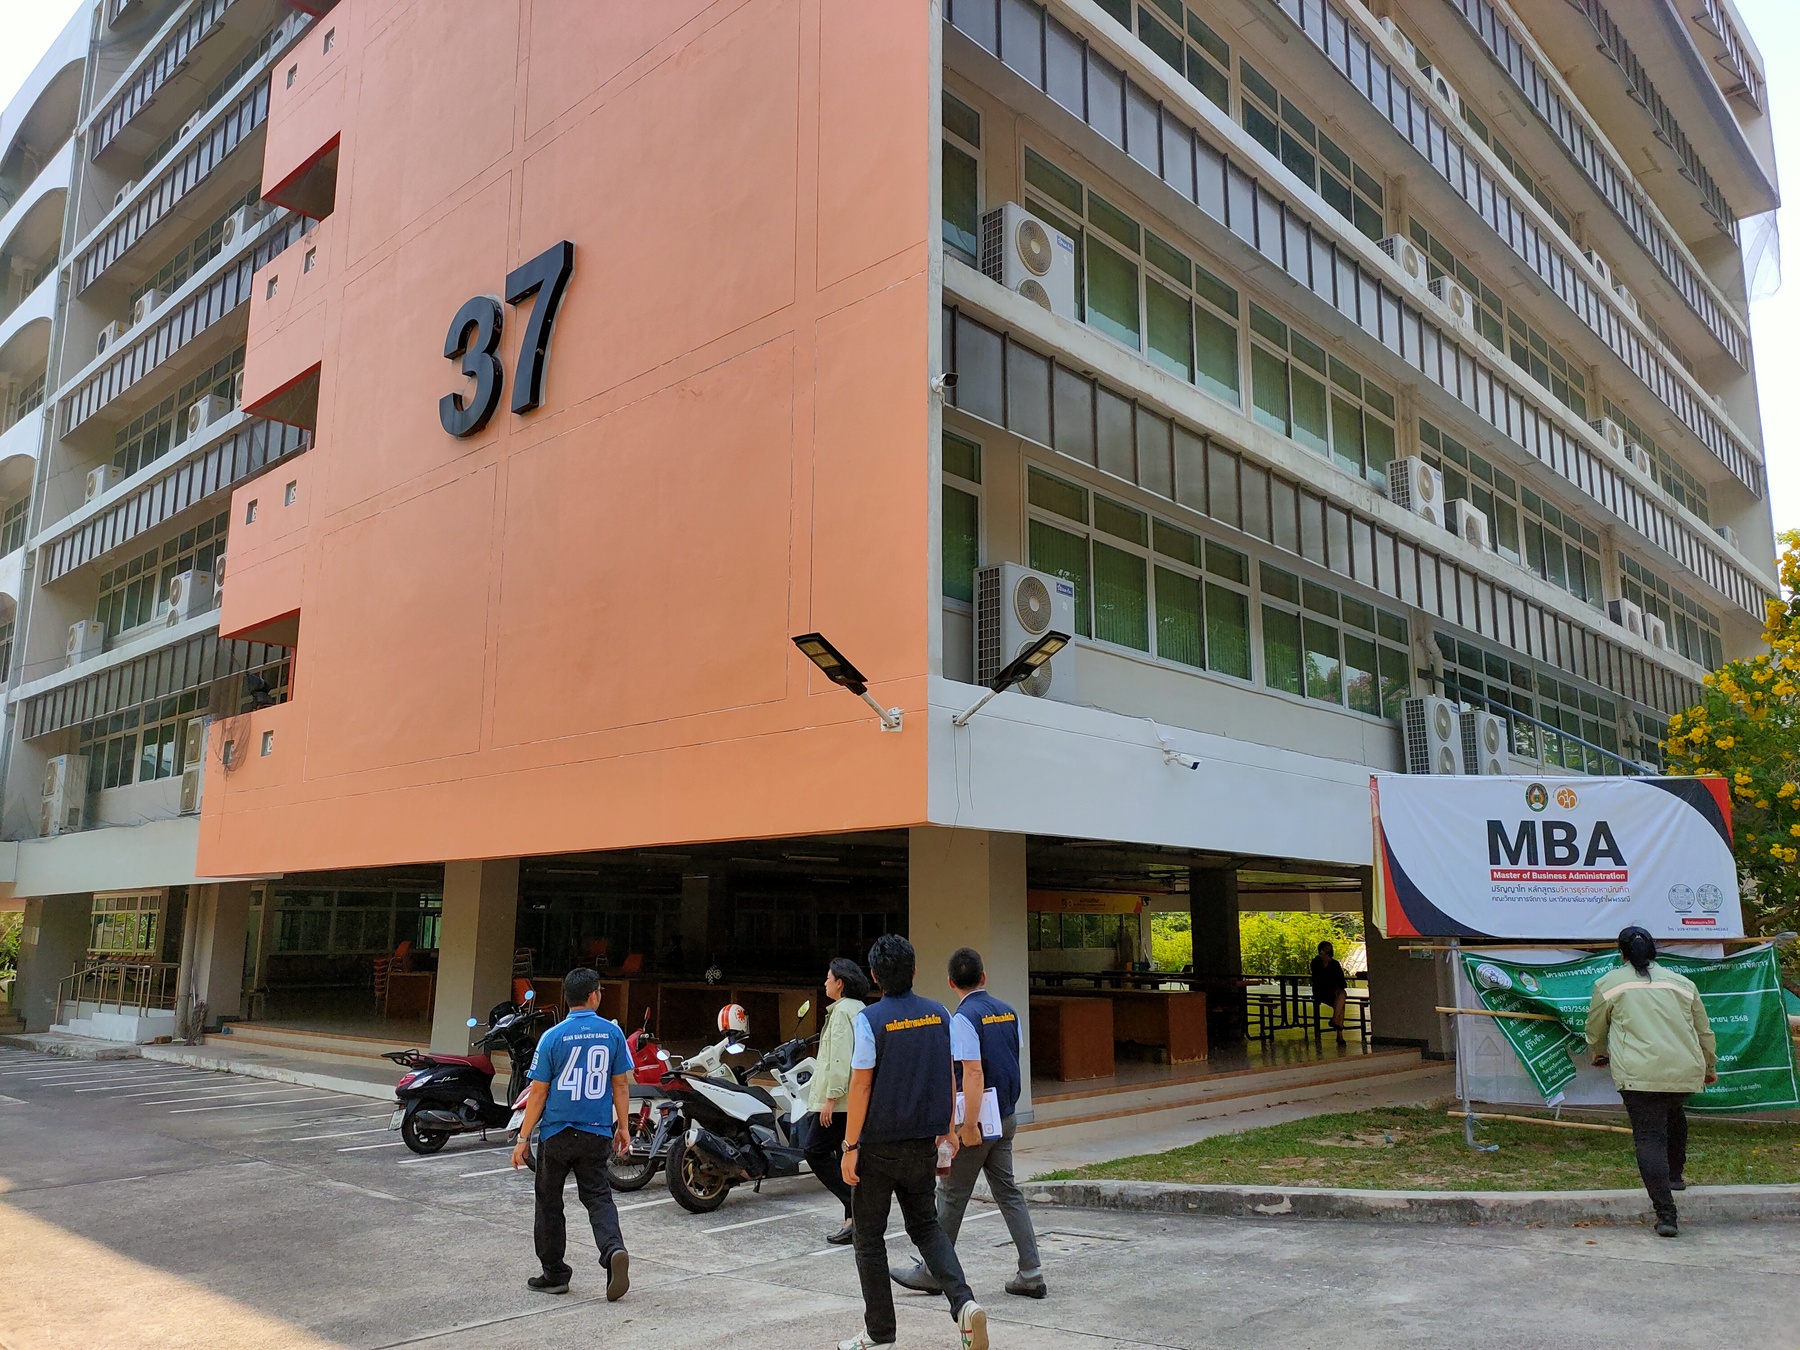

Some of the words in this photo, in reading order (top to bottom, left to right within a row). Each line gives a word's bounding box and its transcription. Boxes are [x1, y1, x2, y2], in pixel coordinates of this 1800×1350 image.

[439, 239, 576, 438] 37
[1487, 819, 1628, 866] MBA
[1493, 871, 1521, 879] Master
[1522, 871, 1531, 879] of
[1532, 871, 1567, 880] Business
[1568, 871, 1626, 880] Administration
[1491, 884, 1526, 893] ปริญญาโท
[1491, 895, 1548, 903] คณะวิทยาการจัดการ
[1730, 1014, 1749, 1022] 2568
[557, 1045, 609, 1101] 48
